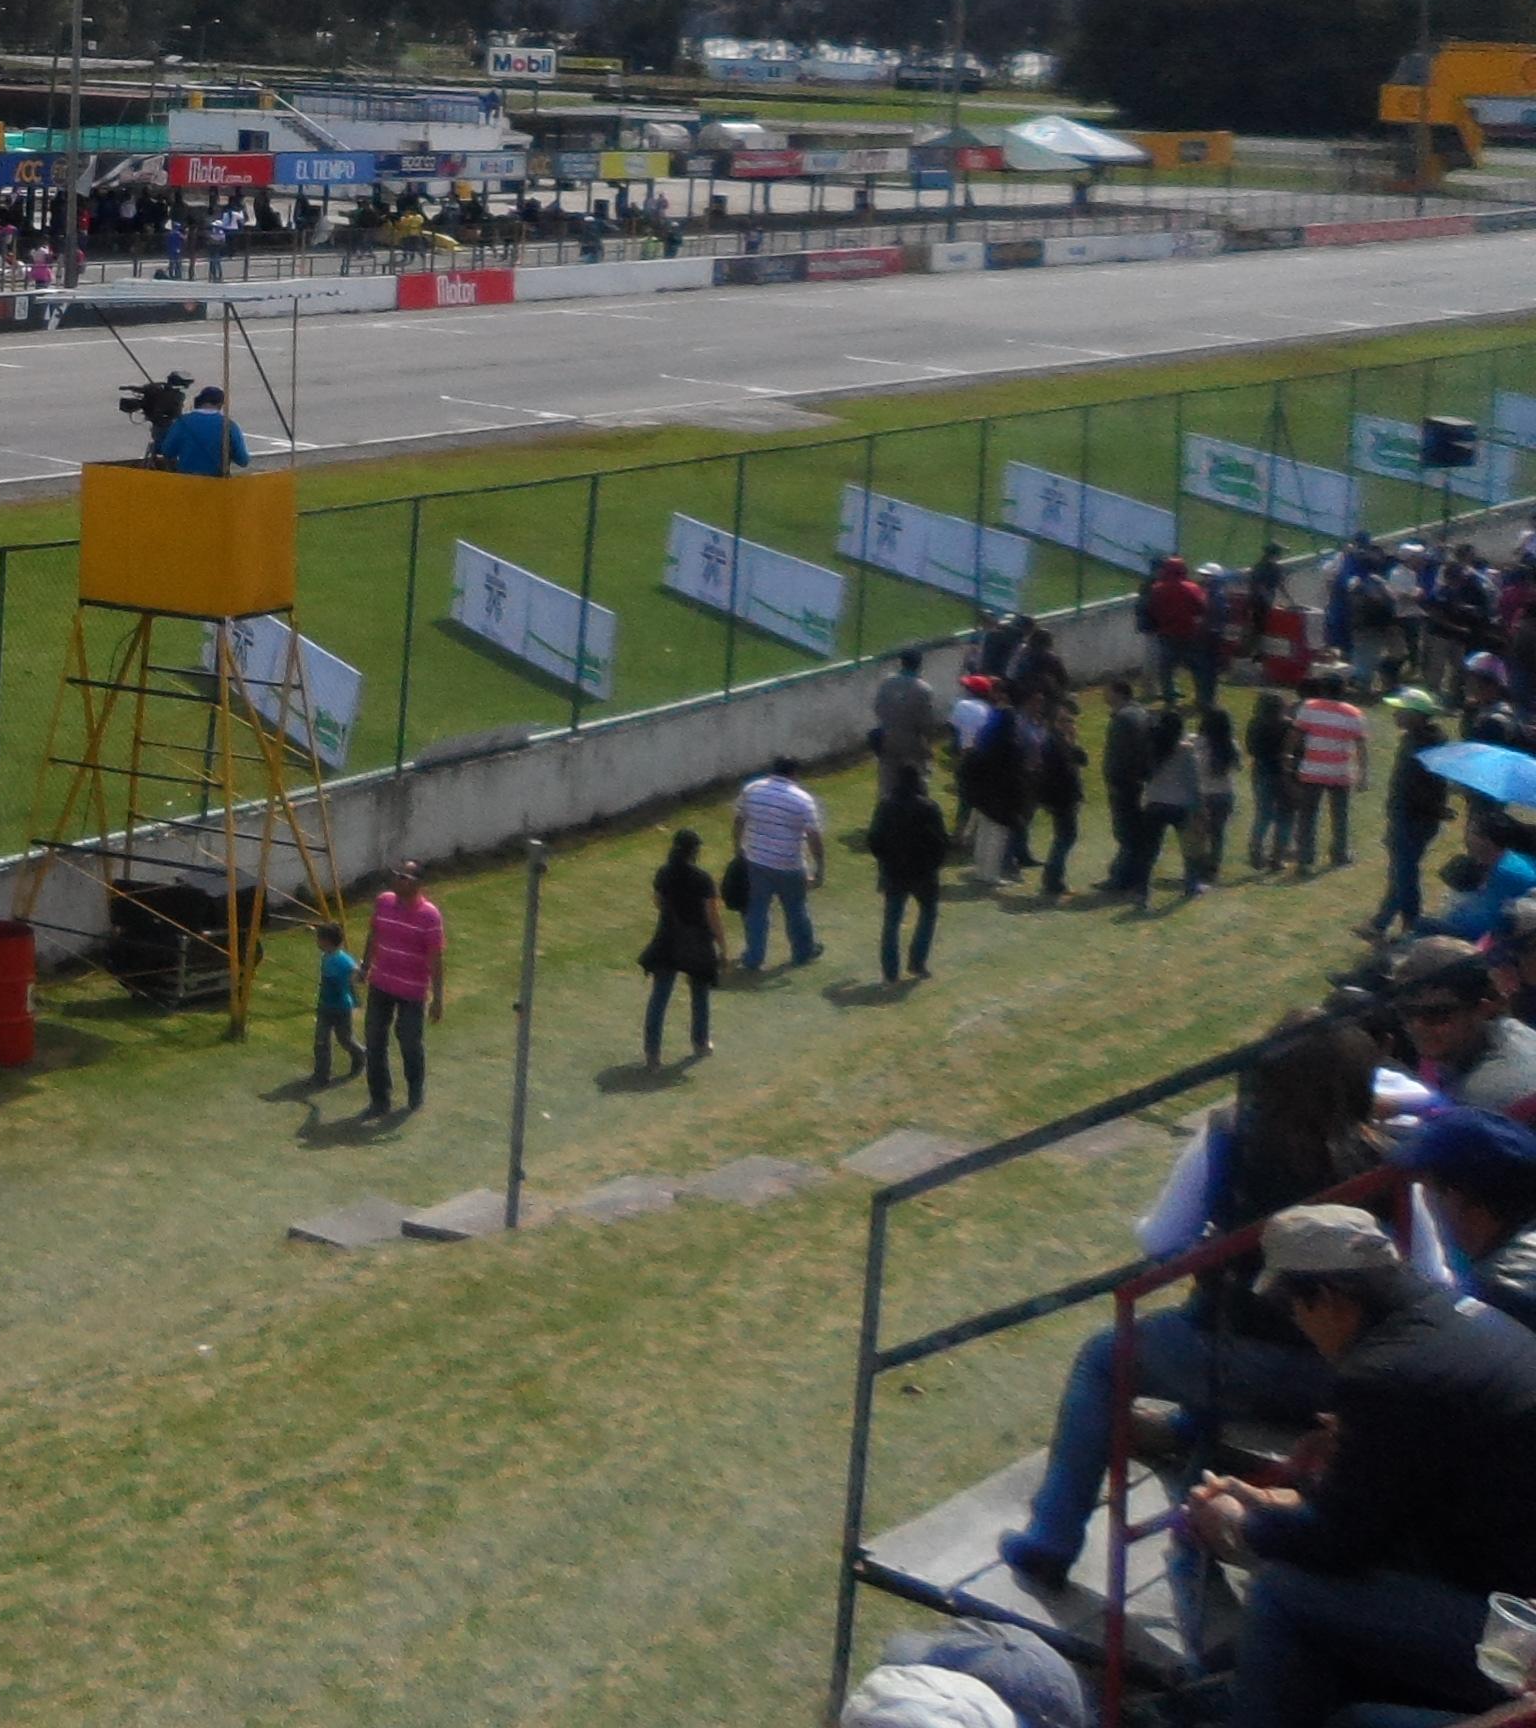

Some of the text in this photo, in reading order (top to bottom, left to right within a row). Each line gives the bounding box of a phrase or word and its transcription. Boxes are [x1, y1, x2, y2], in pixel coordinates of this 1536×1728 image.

[492, 53, 553, 73] Mobil
[15, 158, 44, 183] ACC
[295, 159, 355, 180] EL TIEMPO
[436, 274, 478, 306] Motor
